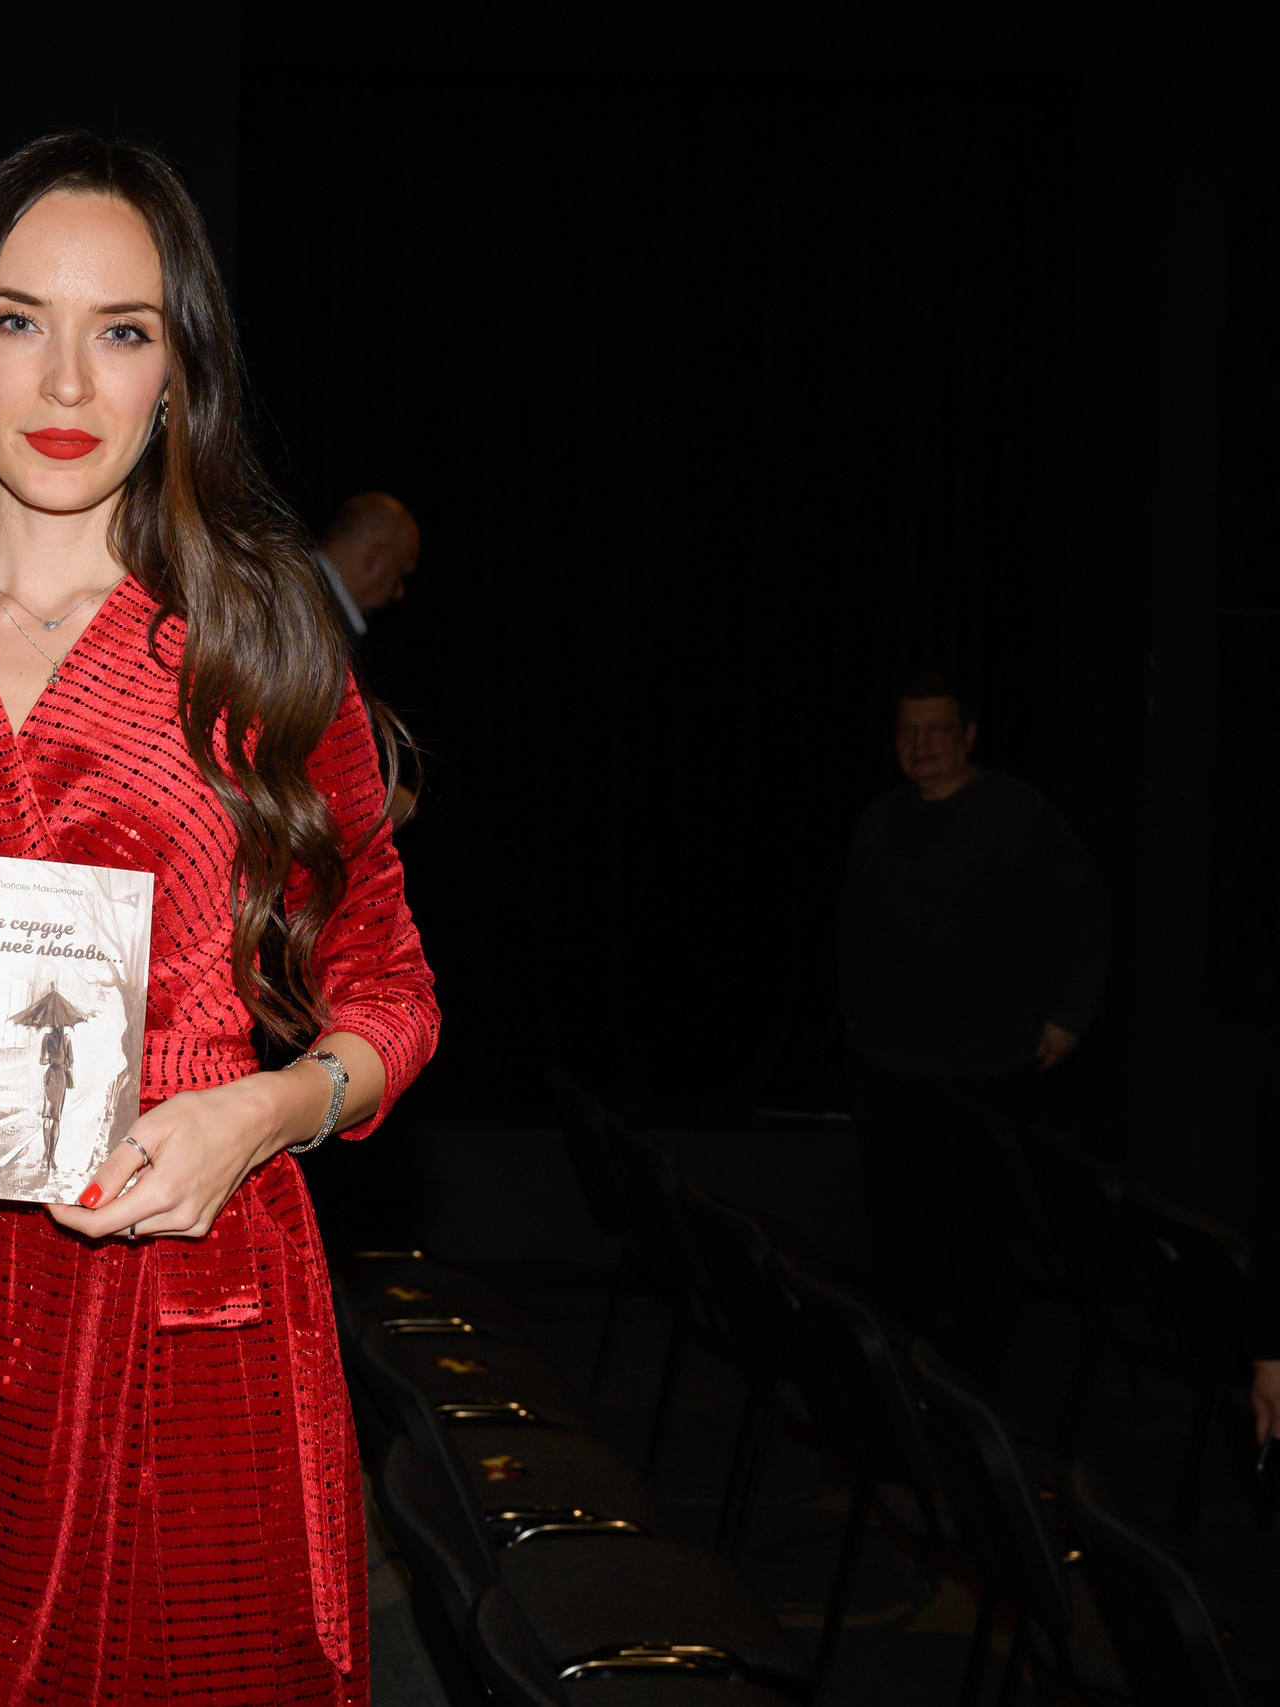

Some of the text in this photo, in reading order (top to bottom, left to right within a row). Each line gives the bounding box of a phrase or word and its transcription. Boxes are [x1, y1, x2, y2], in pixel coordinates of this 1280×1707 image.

[32, 883, 83, 896] Максимова
[10, 918, 75, 940] сердце
[0, 939, 34, 954] неё
[35, 940, 123, 964] любовь...
